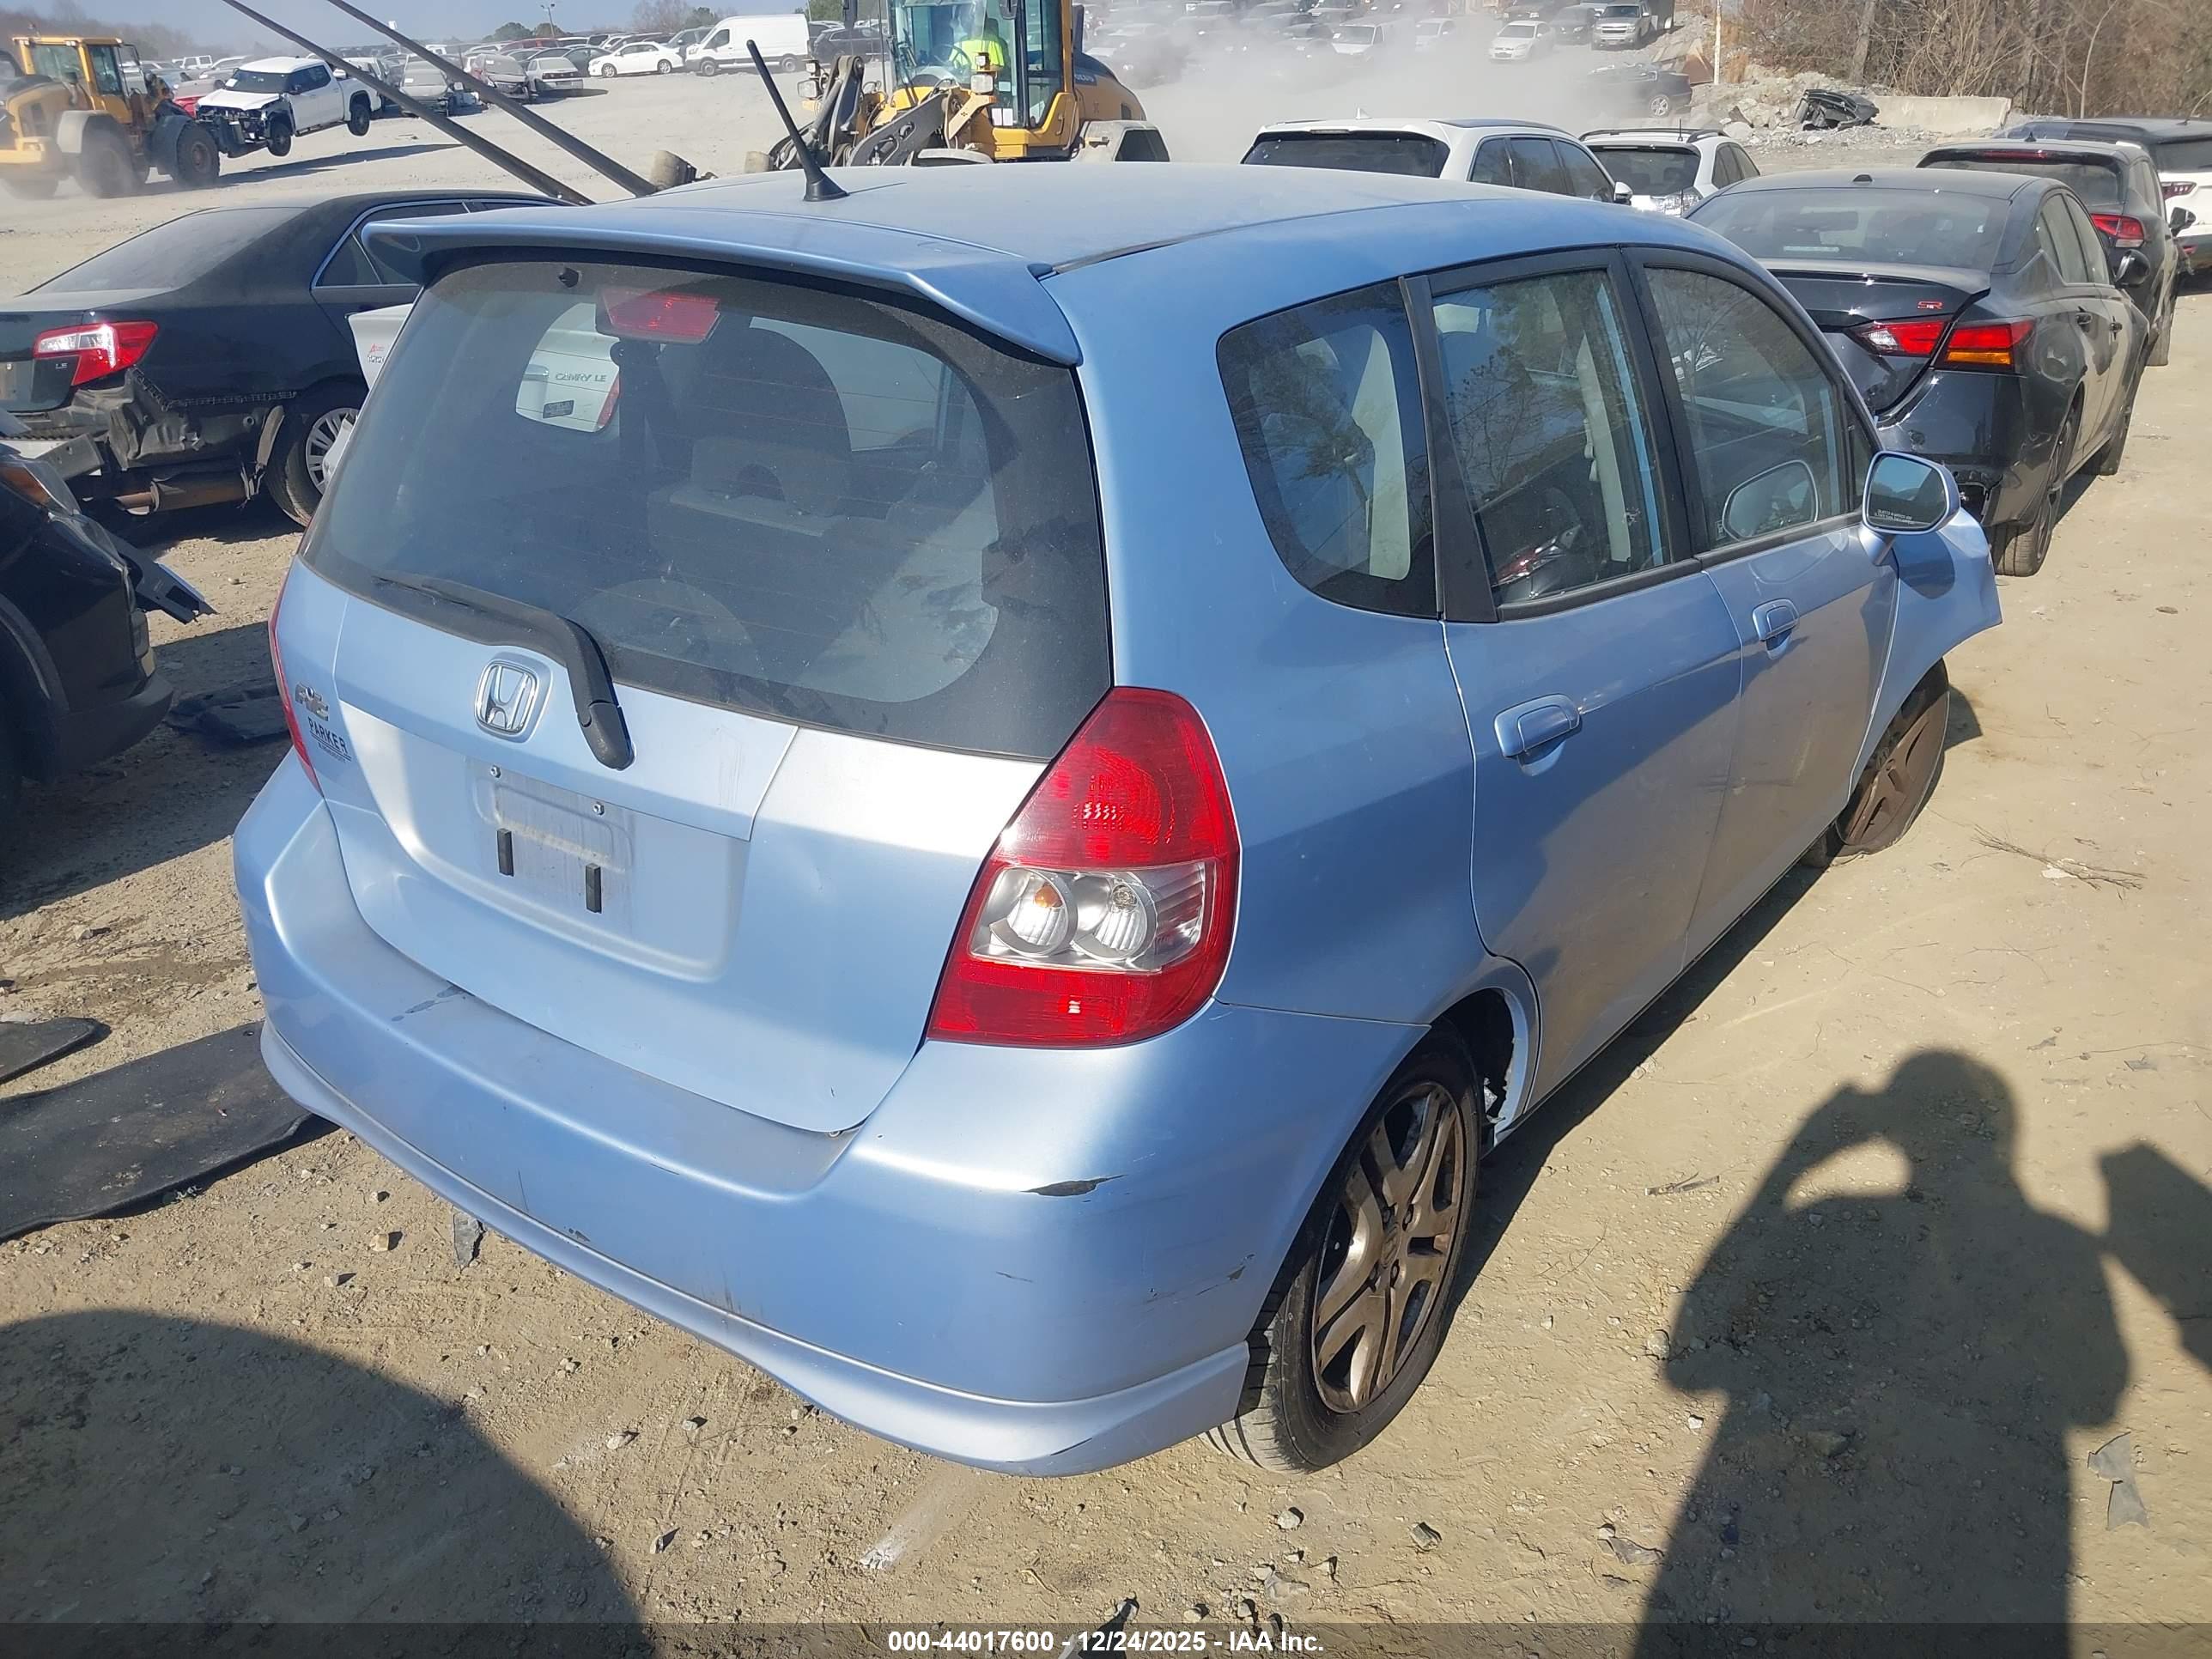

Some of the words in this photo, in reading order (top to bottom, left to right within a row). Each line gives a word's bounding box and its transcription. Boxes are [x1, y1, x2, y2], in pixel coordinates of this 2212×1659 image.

[556, 373, 592, 382] CAMRY
[594, 374, 607, 383] LE
[307, 716, 349, 755] PARKER
